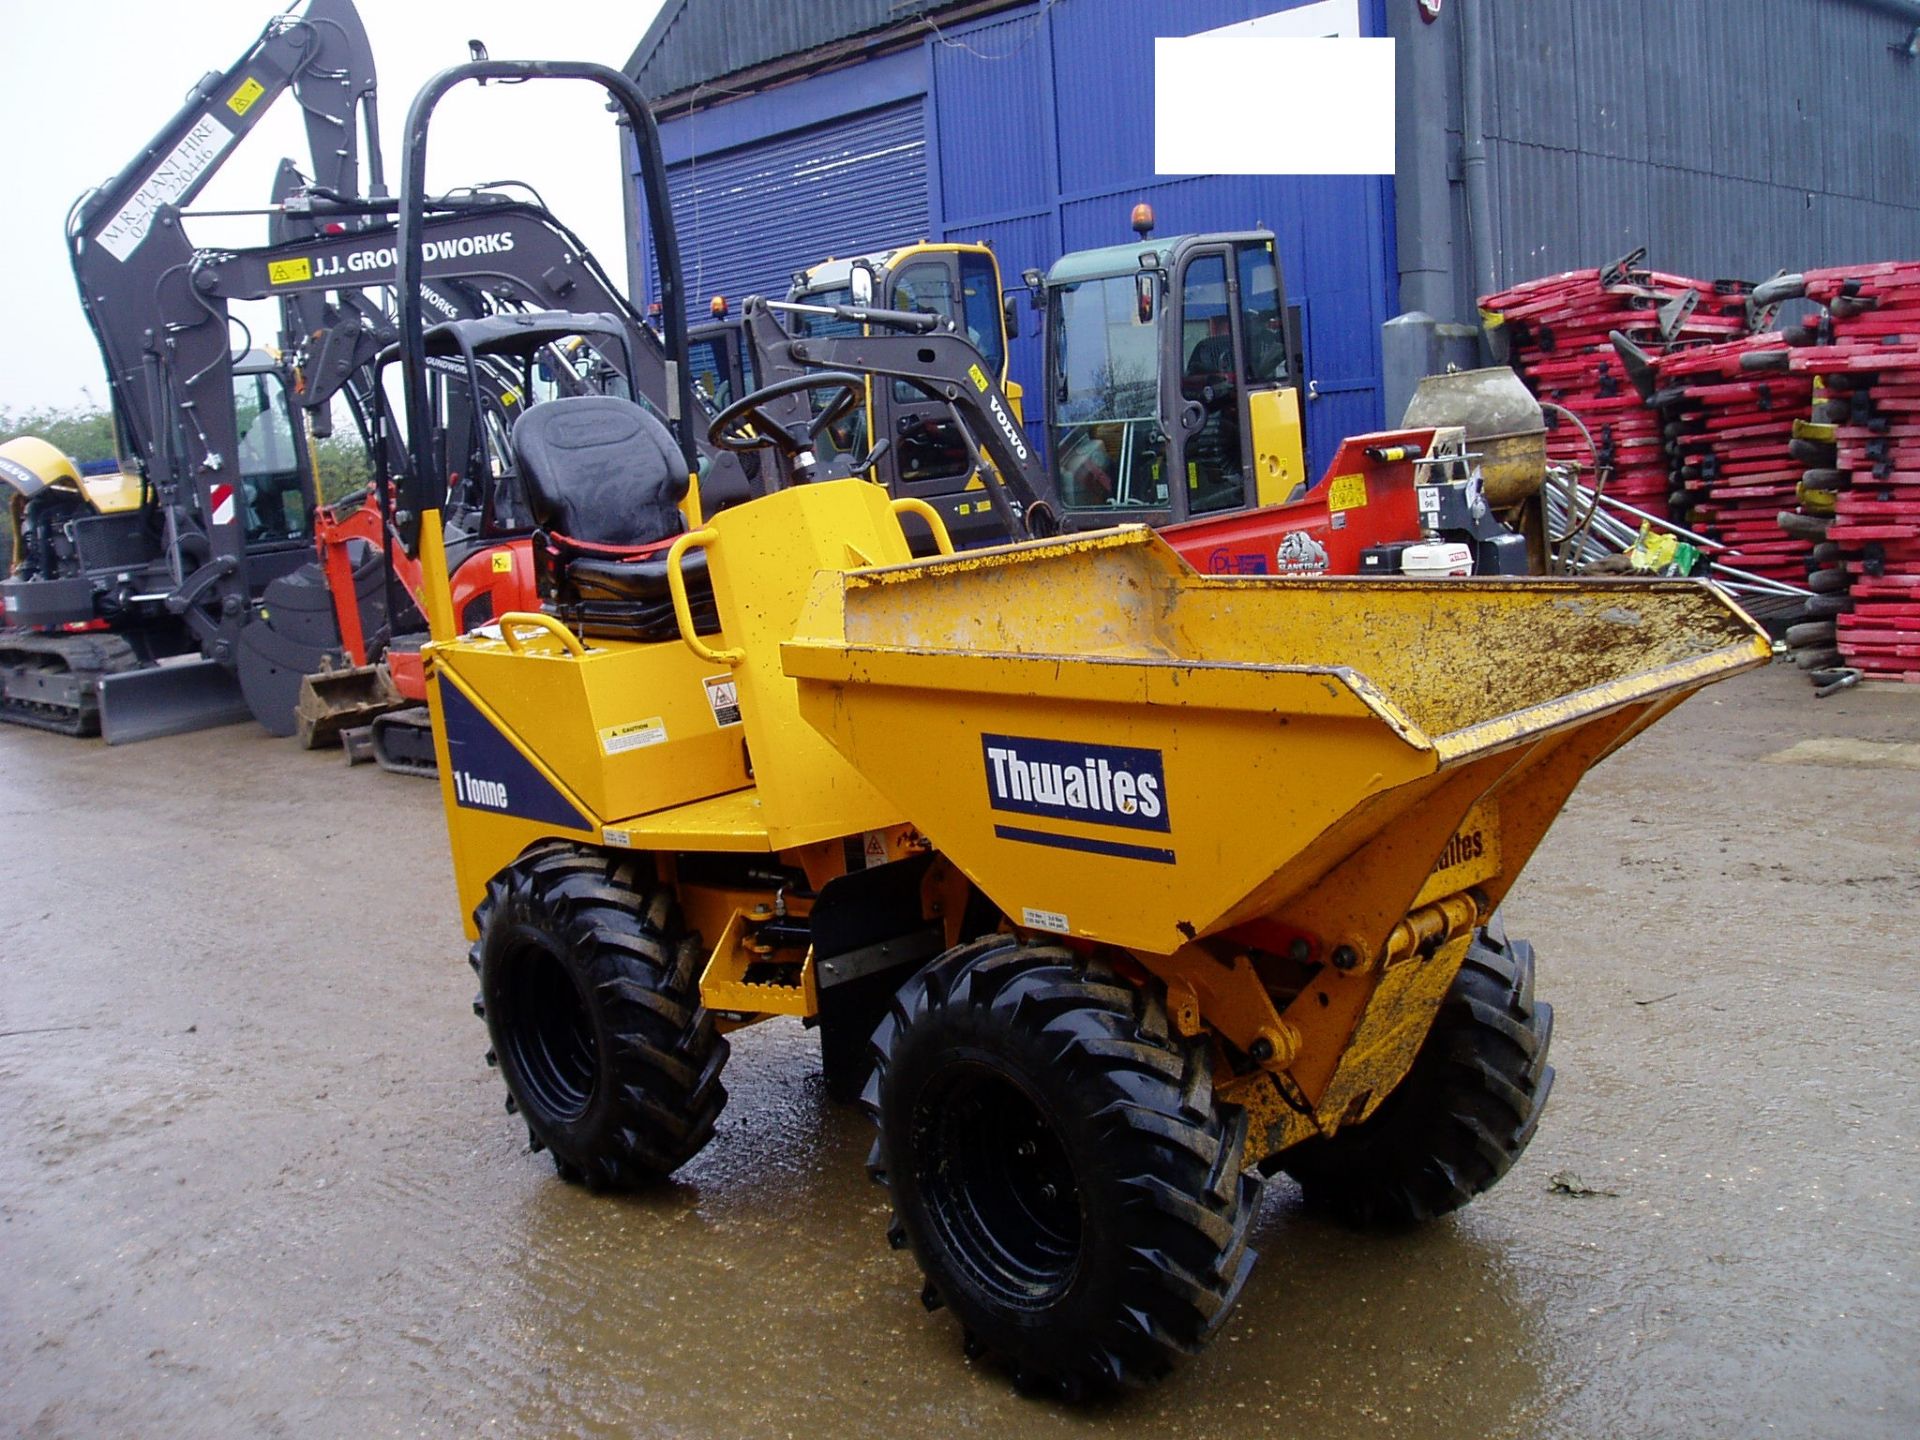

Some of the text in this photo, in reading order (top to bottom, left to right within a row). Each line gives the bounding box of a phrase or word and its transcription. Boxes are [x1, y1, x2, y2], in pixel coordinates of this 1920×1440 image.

[104, 120, 214, 244] M.R. PLANT HIRE
[168, 149, 213, 197] 220446
[314, 232, 514, 277] J.J. GRODWORKS
[420, 283, 458, 318] WORKS
[990, 394, 1027, 460] VOLVO
[622, 723, 649, 734] CAUTION
[453, 771, 508, 808] 1 tonne
[987, 747, 1161, 818] Thwaites
[1432, 830, 1483, 873] aites
